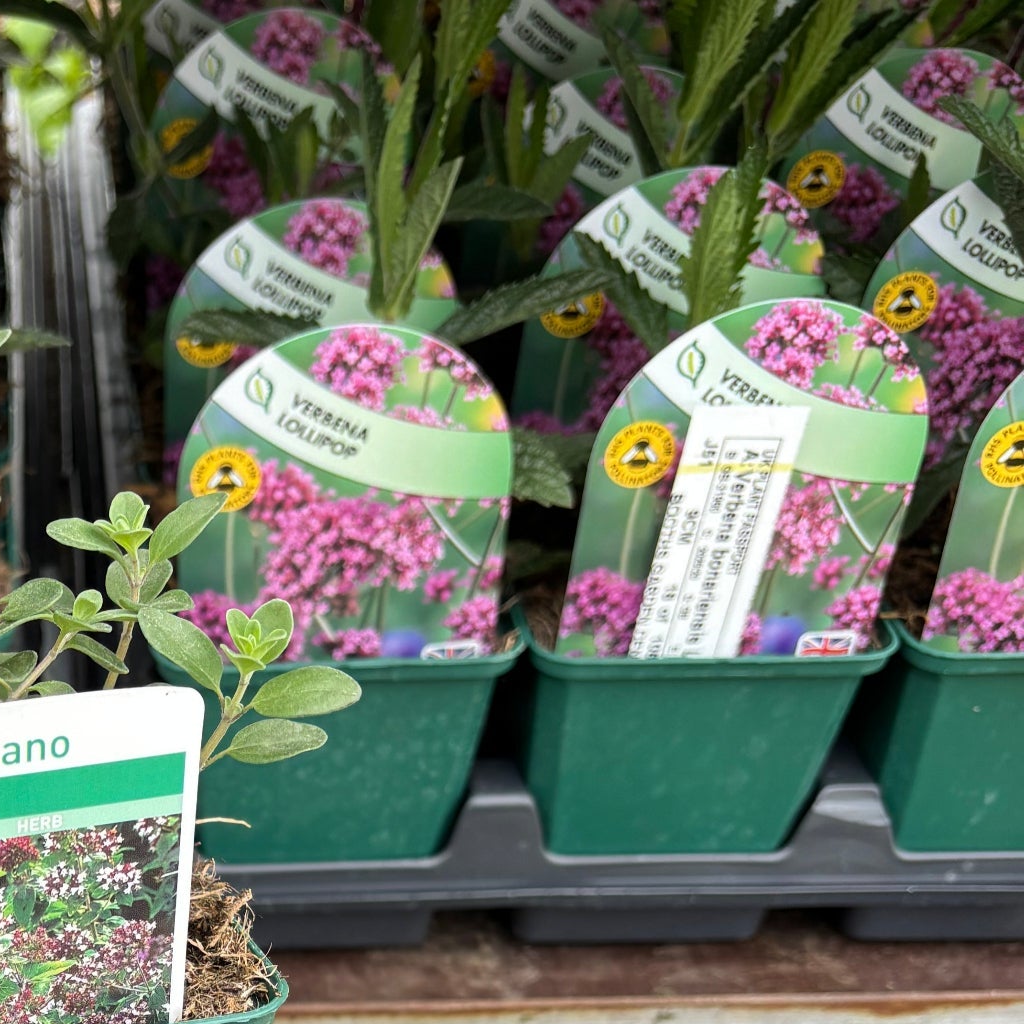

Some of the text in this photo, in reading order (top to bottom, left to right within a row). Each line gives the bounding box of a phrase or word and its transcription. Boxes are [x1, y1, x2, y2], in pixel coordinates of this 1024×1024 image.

[277, 413, 358, 459] LOLLIPOP
[293, 392, 369, 443] VERBENA
[716, 470, 753, 541] Verbena
[726, 511, 756, 576] PASSPORT
[685, 548, 729, 645] bonariensis
[17, 814, 63, 834] HERB
